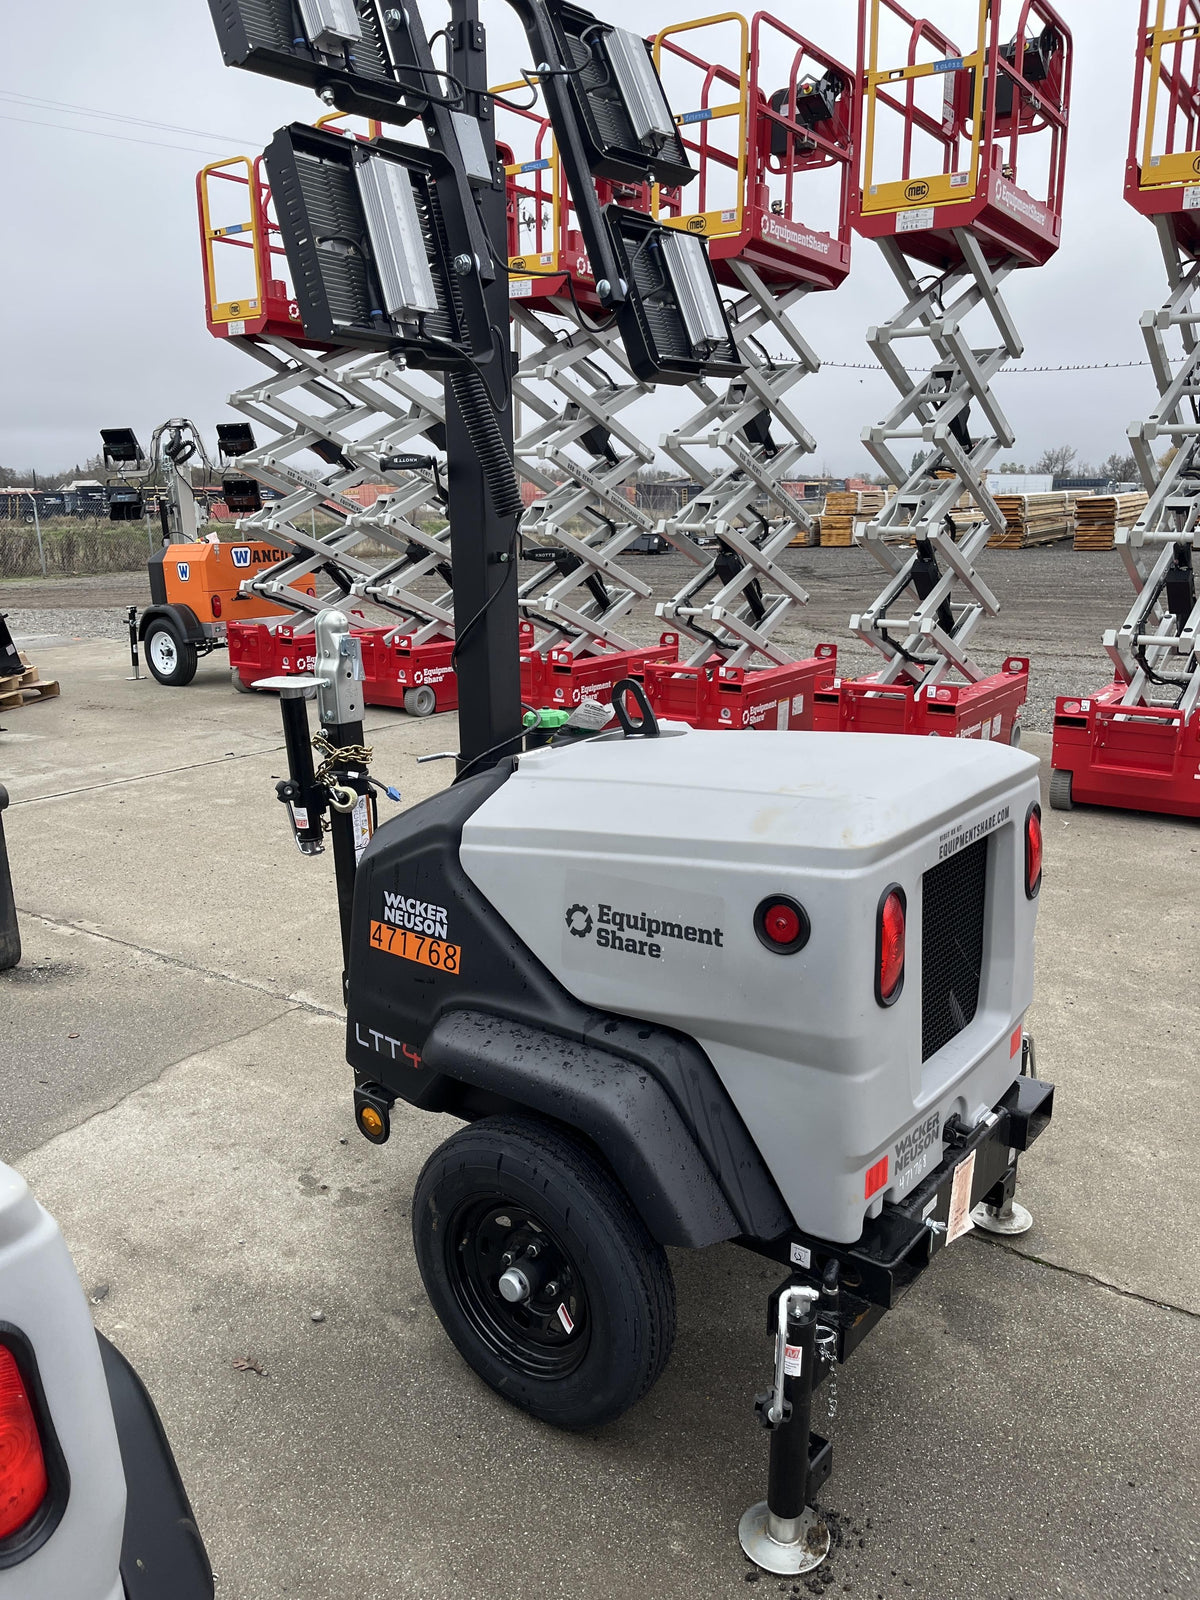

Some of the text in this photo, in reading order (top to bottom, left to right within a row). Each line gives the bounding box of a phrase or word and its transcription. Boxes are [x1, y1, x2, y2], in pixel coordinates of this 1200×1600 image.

[908, 185, 926, 197] mec
[1002, 184, 1047, 227] EquipmentShare
[689, 218, 704, 230] mec
[769, 219, 830, 255] EquipmentShare
[178, 564, 188, 579] W
[423, 674, 442, 684] Share
[581, 681, 611, 696] Equipment
[938, 805, 1010, 860] EQUIPMENTSHARE.COM
[383, 890, 449, 925] WACKER
[384, 906, 448, 940] NEUSON
[596, 927, 662, 959] Share
[597, 903, 724, 948] Equipment
[371, 923, 457, 971] 471768
[355, 1022, 422, 1069] LTT4
[894, 1111, 940, 1158] WACKER
[894, 1125, 940, 1176] NEUSON
